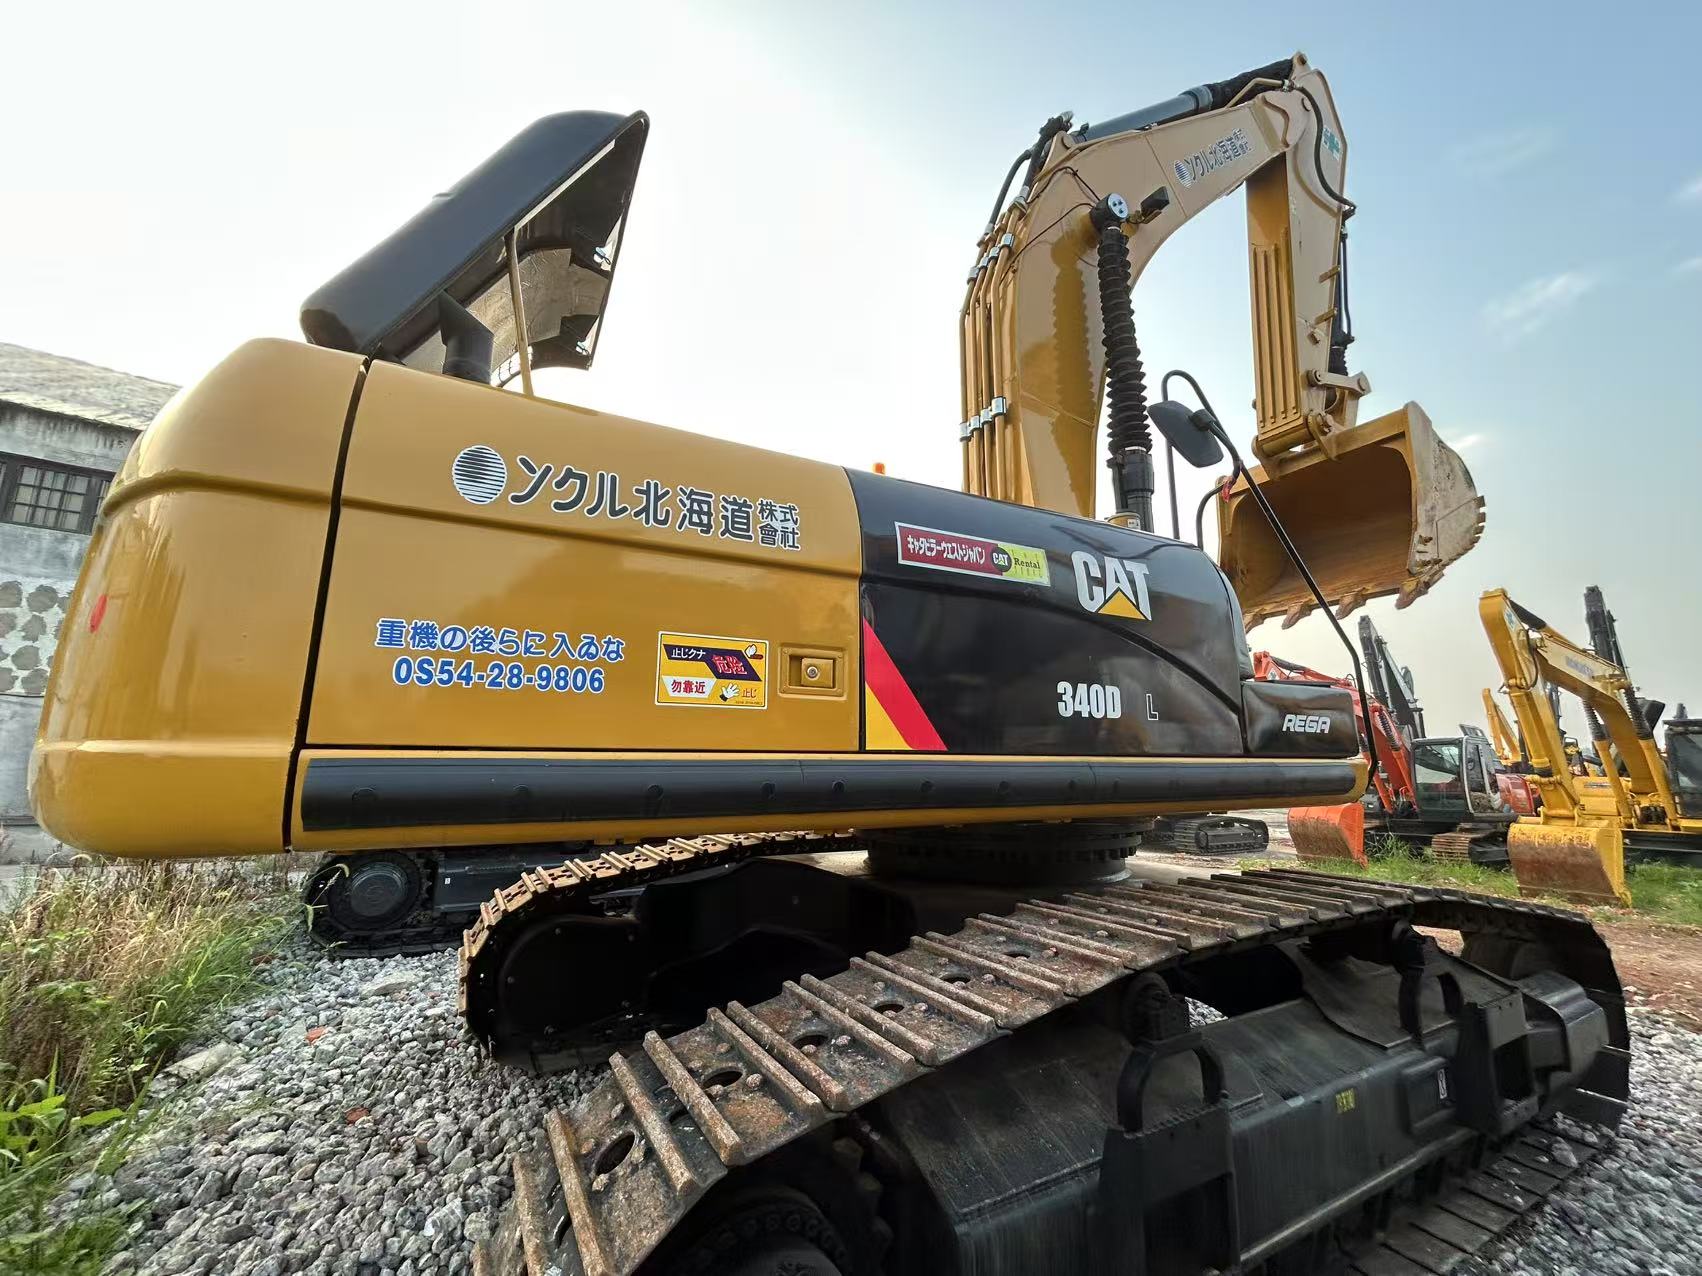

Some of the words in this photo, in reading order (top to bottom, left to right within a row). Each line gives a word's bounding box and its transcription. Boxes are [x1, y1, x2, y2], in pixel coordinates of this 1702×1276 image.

[992, 552, 1009, 567] CAT
[1013, 557, 1041, 570] Rental
[1071, 550, 1152, 621] CAT
[671, 679, 706, 695] 勿靠近
[1057, 681, 1122, 719] 340D
[1146, 693, 1159, 721] L
[1282, 713, 1331, 734] REGA
